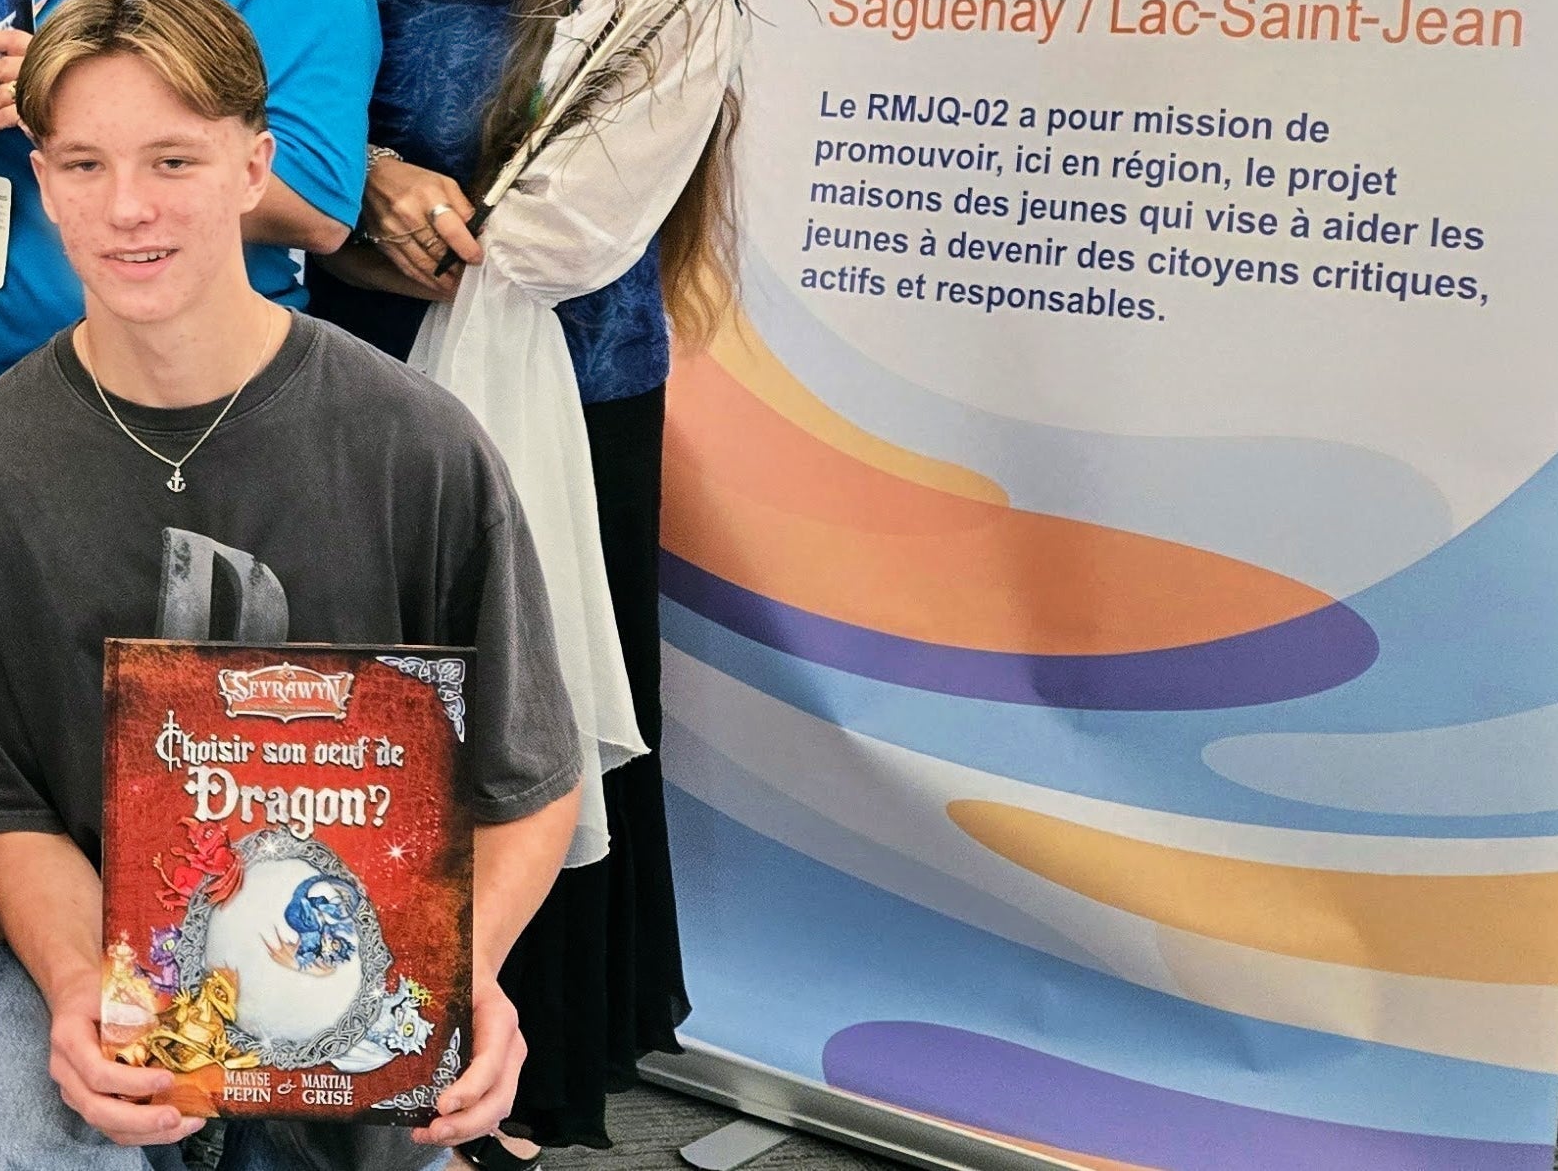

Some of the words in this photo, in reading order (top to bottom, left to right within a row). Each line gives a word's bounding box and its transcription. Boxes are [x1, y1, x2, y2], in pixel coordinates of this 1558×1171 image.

[820, 91, 856, 119] Le
[867, 93, 1009, 127] RMJQ-02
[1019, 107, 1037, 128] a
[1047, 107, 1123, 136] pour
[1133, 105, 1273, 140] mission
[1286, 112, 1330, 143] de
[814, 138, 1004, 177] promouvoir,
[1015, 144, 1051, 174] ici
[1062, 153, 1099, 177] en
[1111, 150, 1231, 190] région,
[1245, 157, 1275, 188] le
[1287, 164, 1397, 201] projet
[810, 179, 942, 212] maisons
[953, 187, 1009, 217] des
[1017, 190, 1127, 225] jeunes
[1139, 201, 1193, 234] qui
[1205, 204, 1278, 236] vise
[1289, 207, 1310, 239] à
[1323, 211, 1419, 245] aider
[1430, 217, 1485, 251] les
[802, 219, 908, 254] jeunes
[919, 228, 936, 256] à
[947, 232, 1068, 266] devenir
[1077, 241, 1135, 272] des
[1147, 246, 1299, 287] citoyens
[1312, 260, 1488, 306] critiques,
[800, 266, 885, 296] actifs
[896, 273, 926, 300] et
[936, 280, 1165, 322] responsables.
[155, 710, 255, 772] Choisir
[263, 742, 306, 764] son
[314, 735, 370, 770] oeuf
[374, 735, 405, 767] de
[183, 766, 390, 840] Dragon?
[223, 1087, 271, 1102] PEPIN
[224, 1071, 271, 1086] MARYSE
[277, 1079, 297, 1095] &
[301, 1073, 353, 1089] MARTIAL
[302, 1089, 354, 1105] GRISÉ
